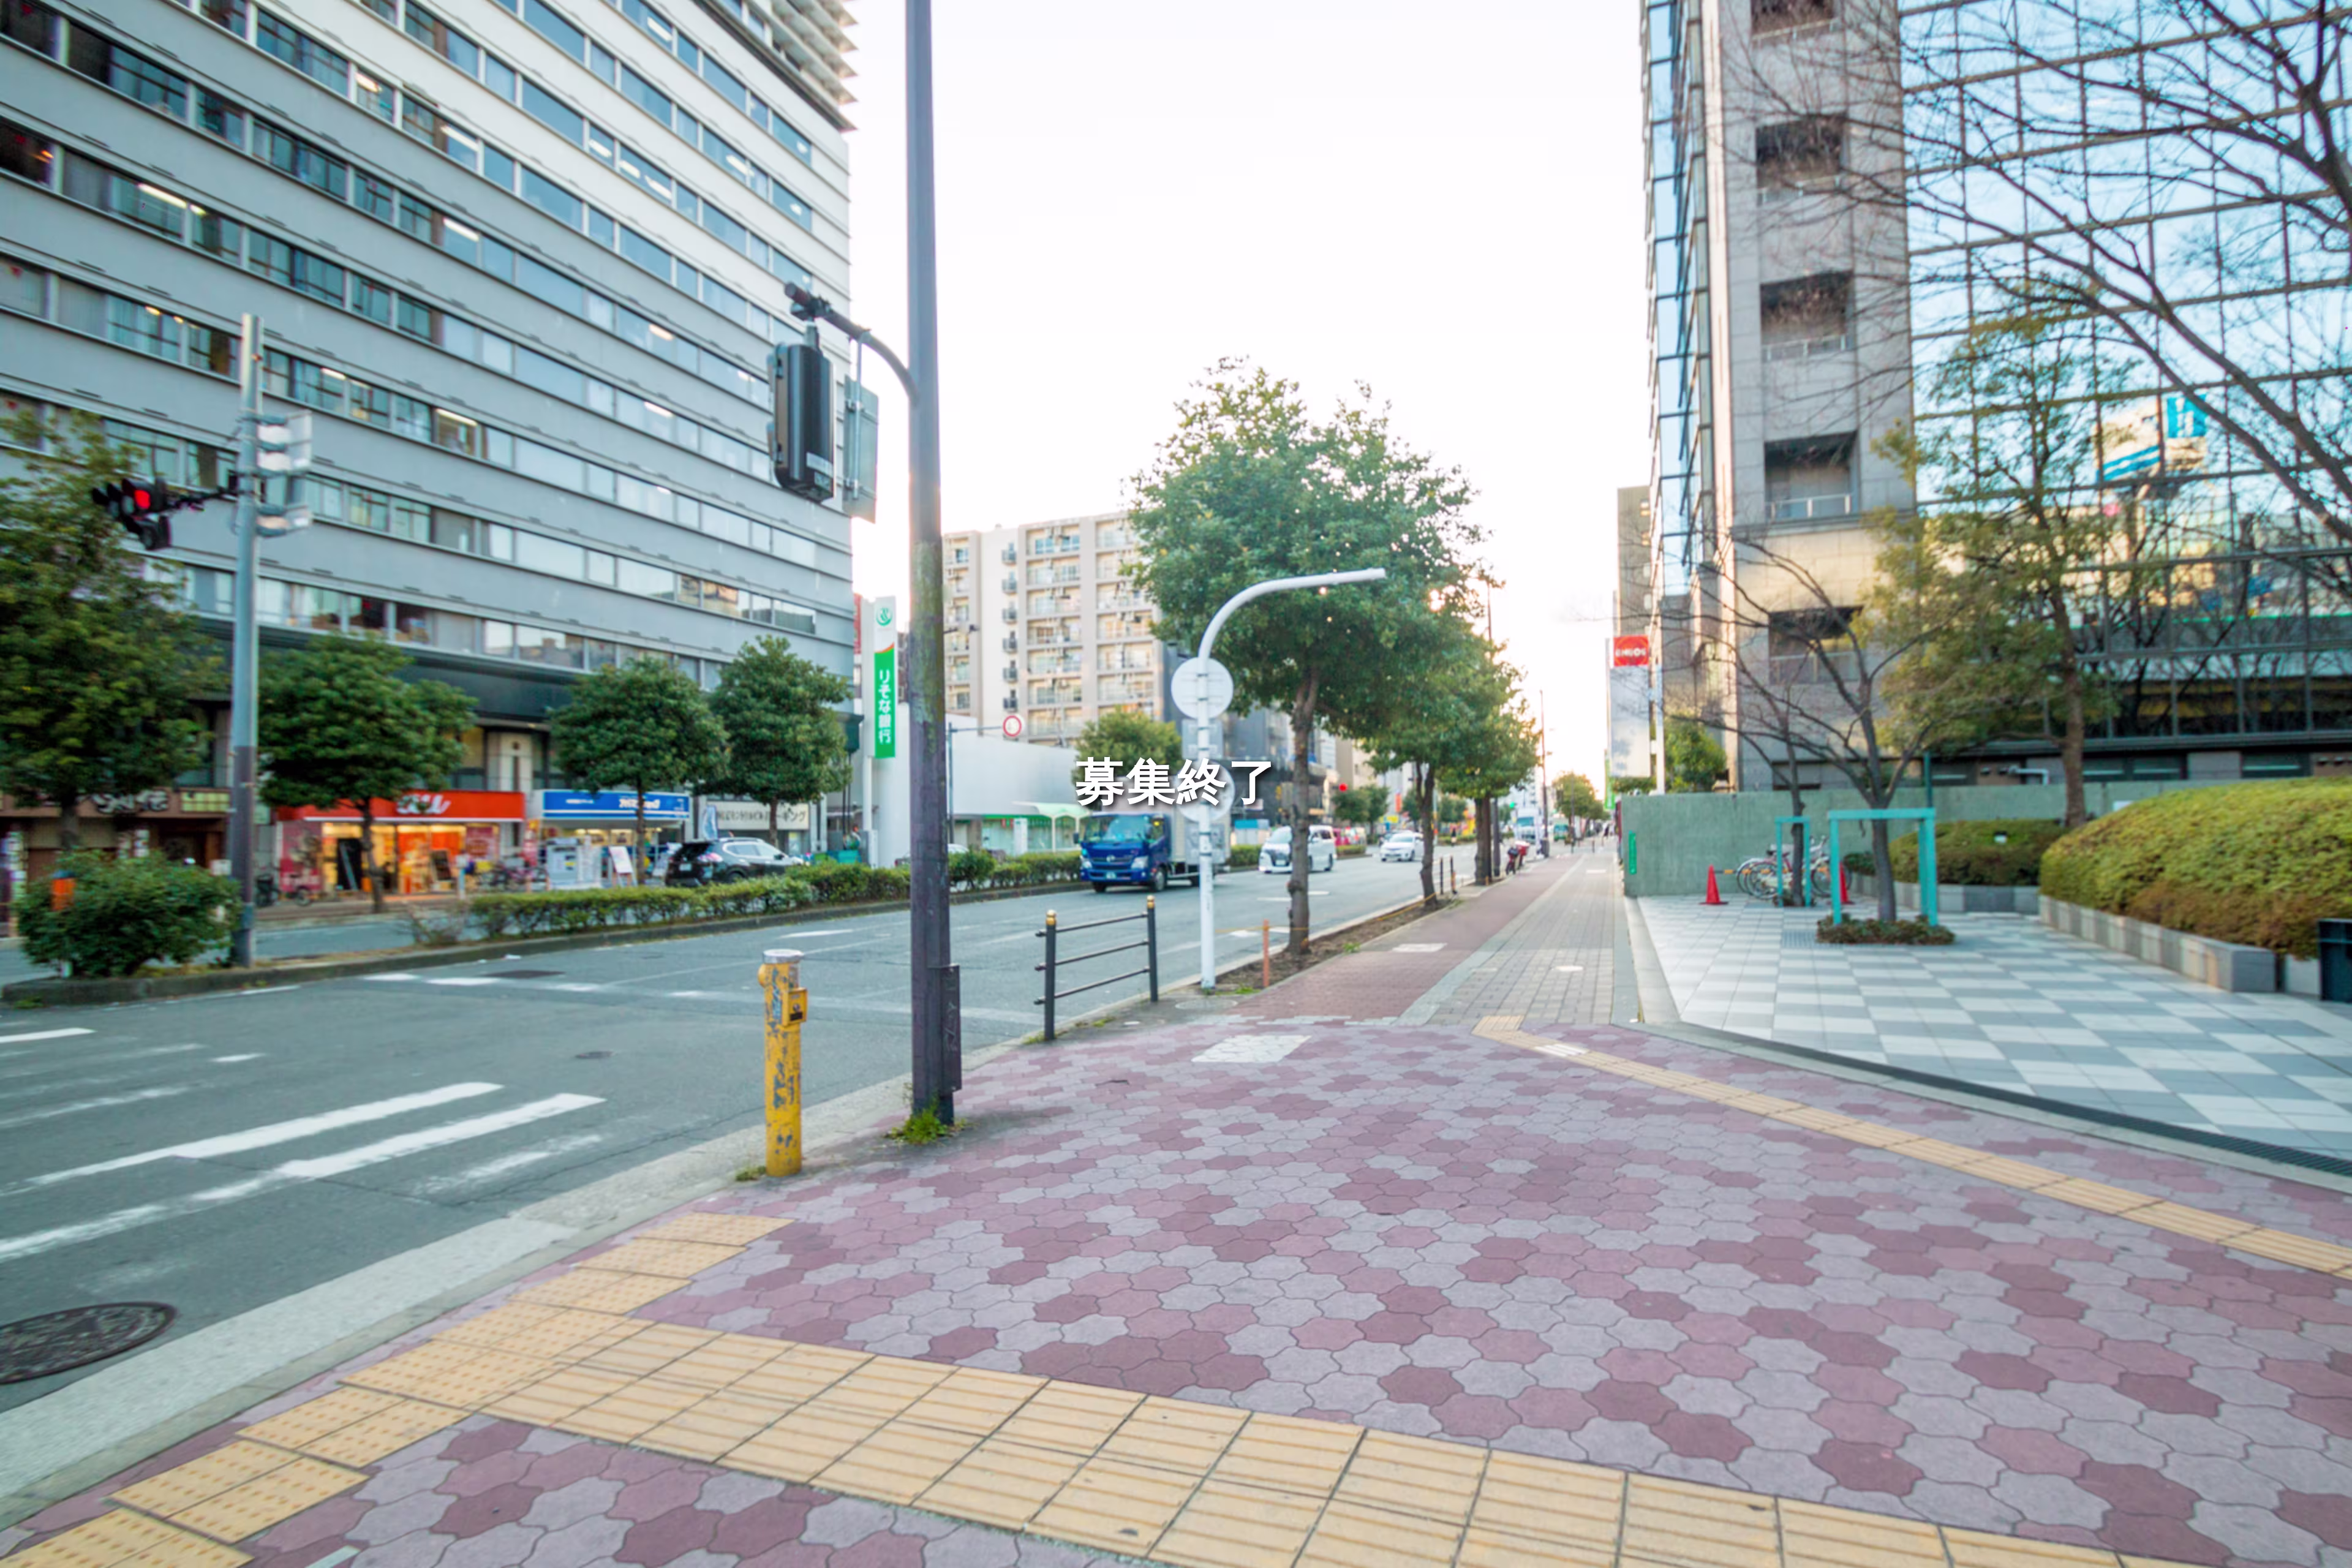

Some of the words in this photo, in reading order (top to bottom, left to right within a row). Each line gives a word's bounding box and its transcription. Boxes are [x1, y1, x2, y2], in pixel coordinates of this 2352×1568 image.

[878, 669, 892, 744] りそな銀行
